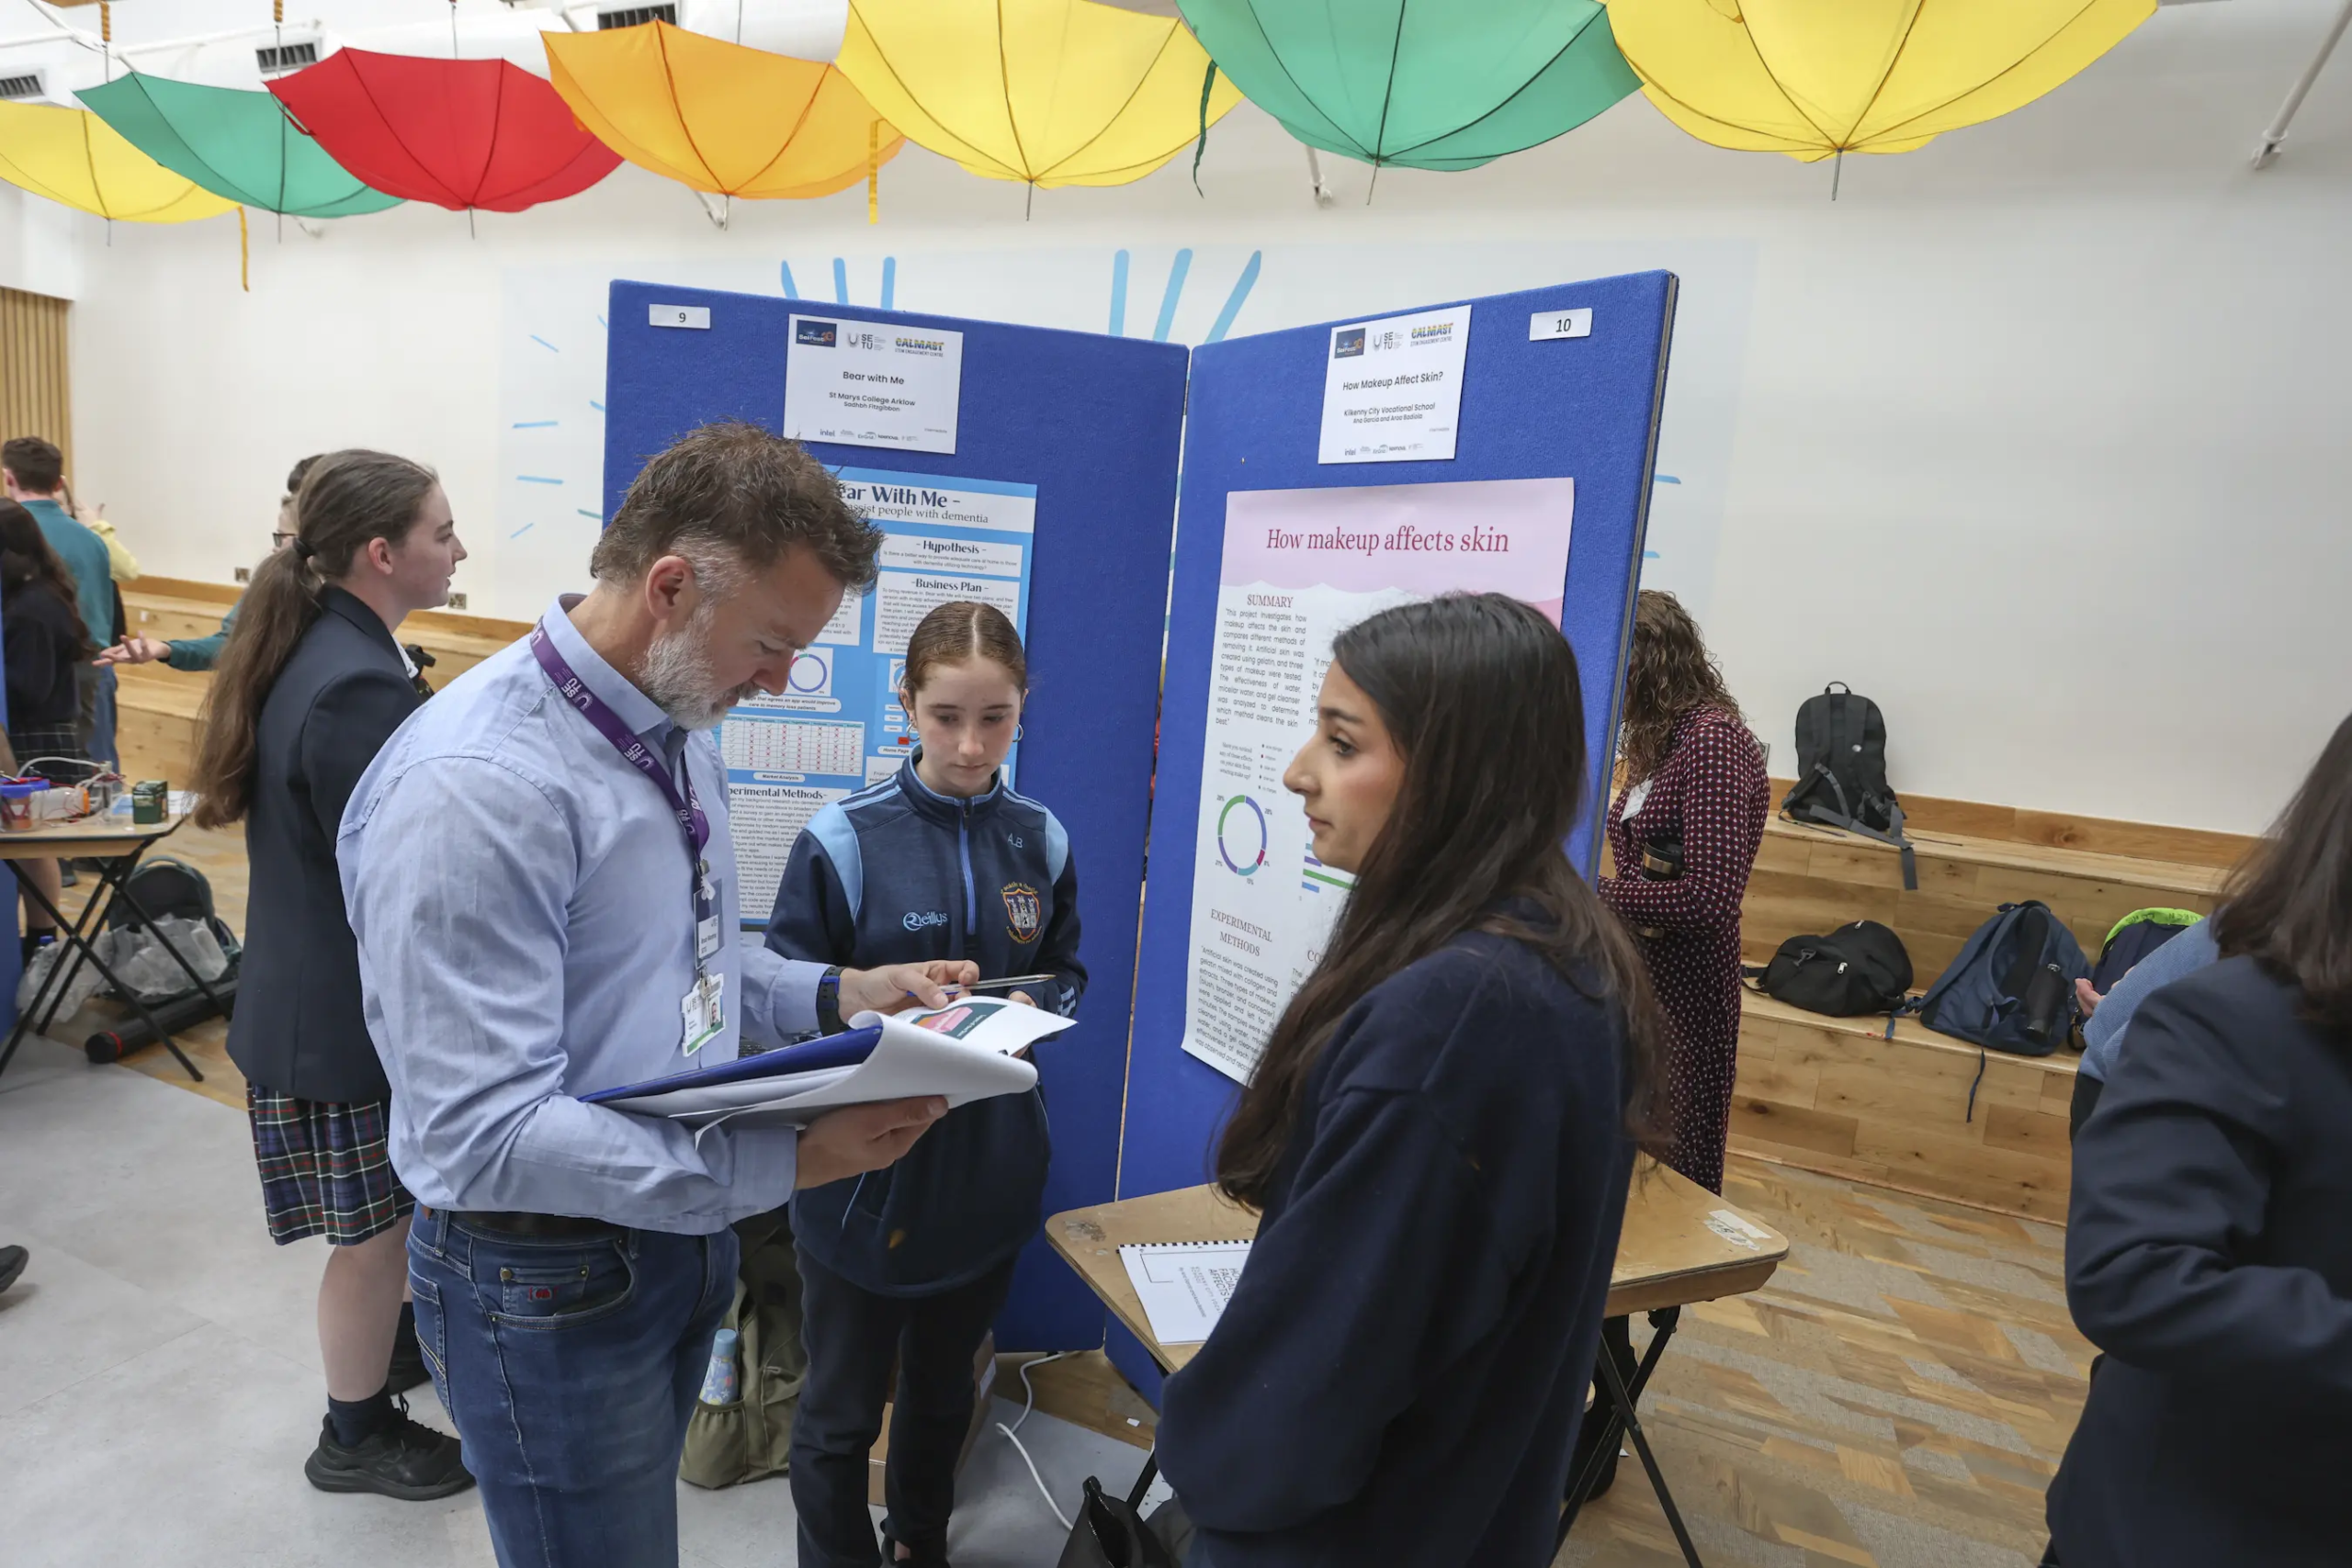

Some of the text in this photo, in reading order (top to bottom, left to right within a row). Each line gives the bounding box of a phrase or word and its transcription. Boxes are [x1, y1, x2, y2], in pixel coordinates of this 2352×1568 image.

[679, 312, 686, 322] 9
[1411, 322, 1453, 338] CALMAST
[1556, 319, 1571, 333] 10
[1385, 332, 1393, 341] SE
[896, 338, 944, 351] CALMAST
[1385, 341, 1393, 349] TU
[843, 372, 904, 384] Bear with Me
[1343, 371, 1442, 390] How Makeup Affect Skin?
[838, 393, 860, 401] Marys
[862, 395, 889, 404] College
[891, 398, 915, 406] Arklow
[868, 403, 899, 412] Fitzgibbon
[1344, 409, 1367, 417] Kilkenny
[1382, 404, 1413, 413] Vocational
[1415, 402, 1435, 411] School
[840, 486, 947, 508] ear With Me
[878, 505, 912, 518] people
[916, 508, 939, 519] with
[942, 511, 989, 523] dementia
[923, 540, 979, 554] Hypothesis
[1267, 525, 1509, 556] How makeup affects skin
[961, 581, 982, 592] Plan
[1247, 594, 1293, 607] SUMMARY
[1224, 620, 1244, 629] makeup
[1249, 622, 1265, 630] affects
[1224, 631, 1248, 639] compares
[1250, 633, 1272, 641] different
[1274, 637, 1296, 645] methods
[1222, 642, 1245, 652] removing
[1256, 646, 1276, 654] Artificial
[1242, 656, 1255, 665] using
[1220, 663, 1234, 671] types
[1245, 667, 1265, 677] makeup
[1235, 676, 1267, 687] effectiveness
[1218, 685, 1238, 694] micellar
[1277, 694, 1300, 704] cleanser
[1233, 699, 1256, 708] analyzed
[1272, 705, 1299, 716] determine
[1234, 710, 1253, 718] method
[1256, 714, 1272, 722] cleans
[729, 787, 779, 796] perimental
[1211, 908, 1272, 942] EXPERIMENTAL
[1219, 931, 1260, 956] METHODS
[1200, 958, 1277, 997] gelatin mixed with collagen and
[1223, 956, 1231, 964] skin
[1233, 960, 1242, 970] was
[1244, 965, 1263, 978] created
[1264, 975, 1278, 988] using
[1220, 976, 1233, 987] Three
[1235, 984, 1248, 994] types
[1255, 993, 1276, 1009] makeup
[1237, 996, 1246, 1004] and
